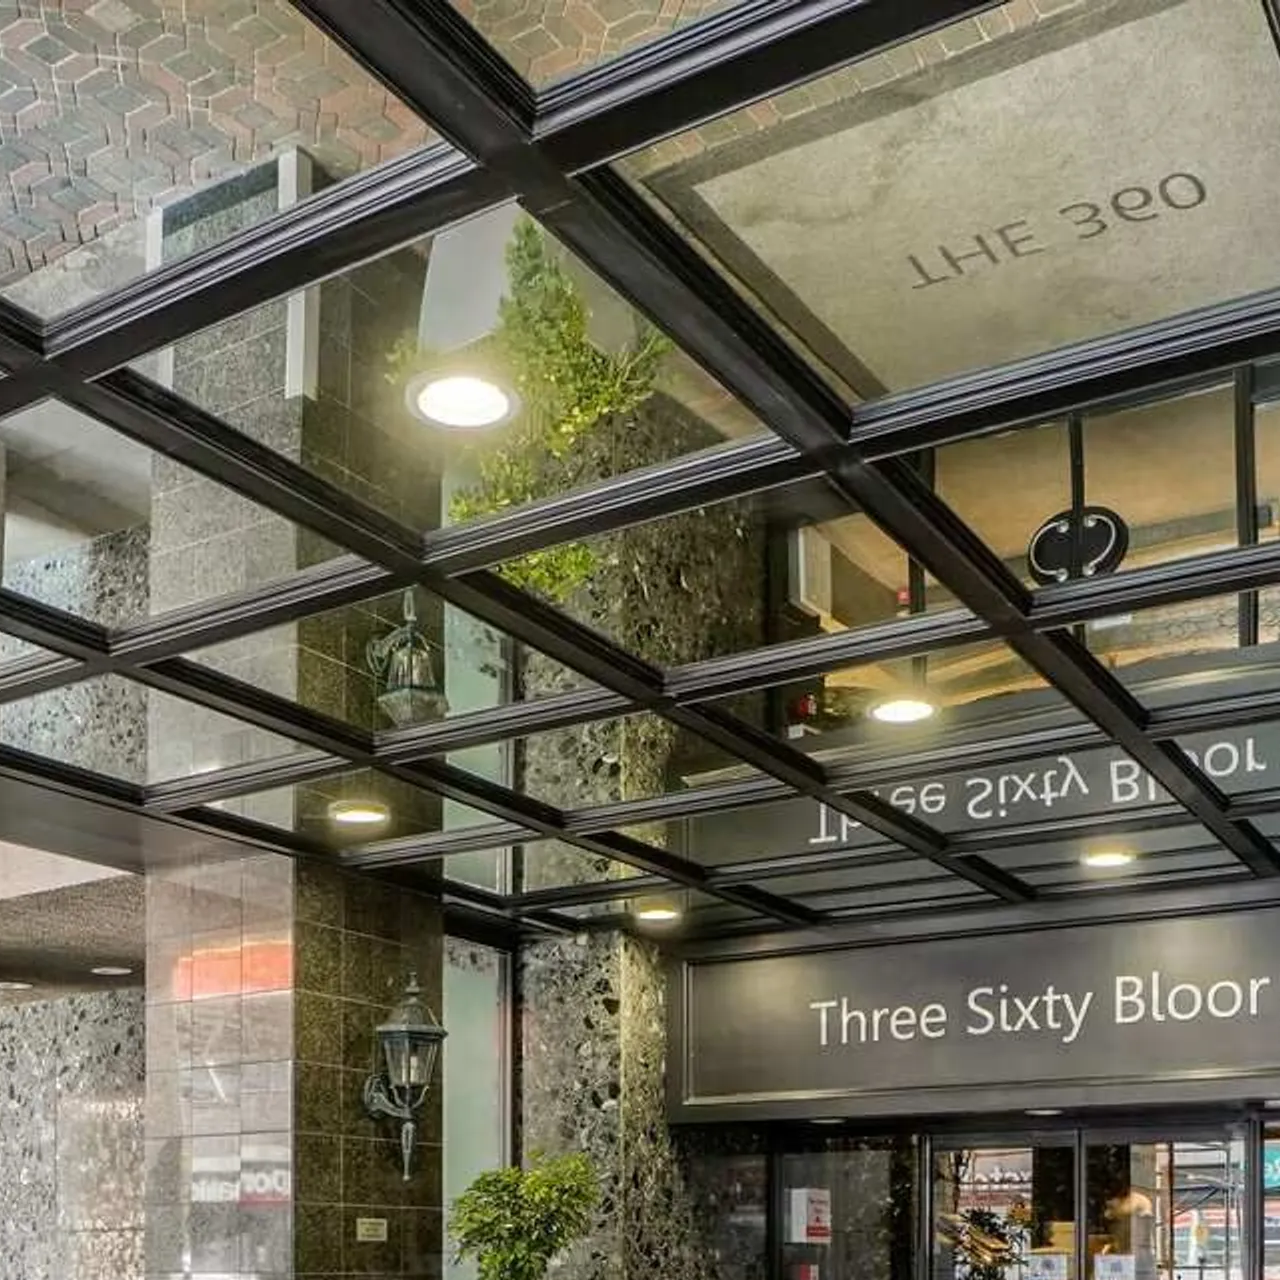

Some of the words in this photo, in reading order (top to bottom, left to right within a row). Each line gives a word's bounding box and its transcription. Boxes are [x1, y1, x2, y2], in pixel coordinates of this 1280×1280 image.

[810, 996, 947, 1046] Three
[966, 984, 1093, 1043] Sixty
[1114, 971, 1270, 1024] Bloor
